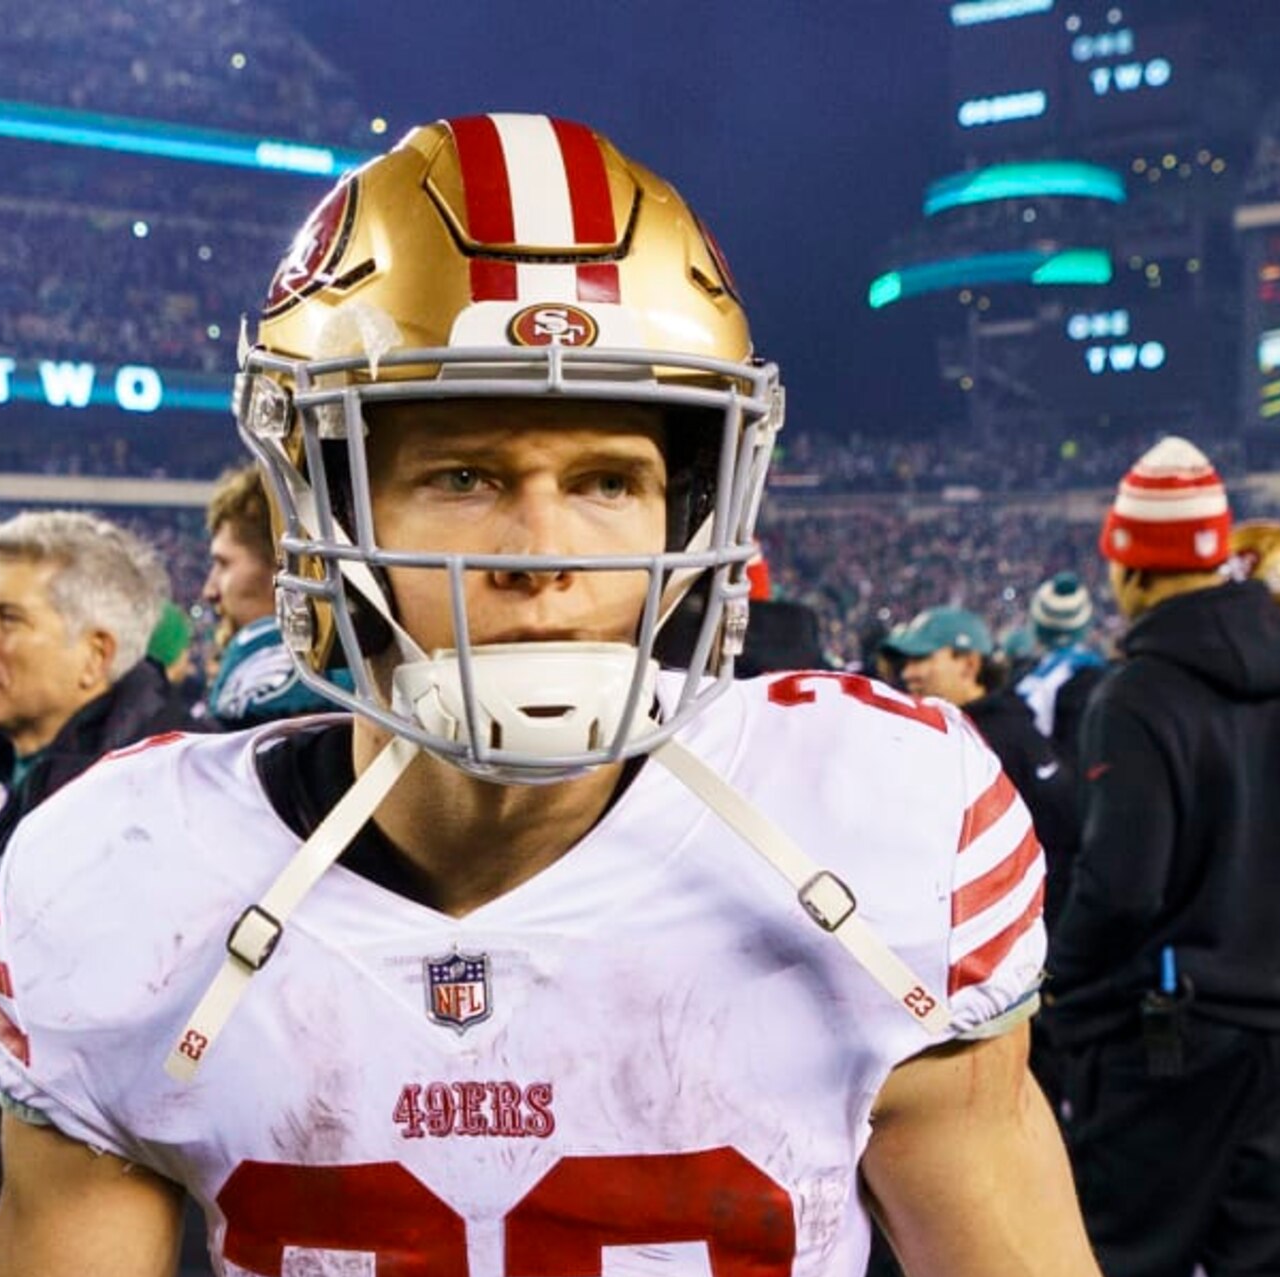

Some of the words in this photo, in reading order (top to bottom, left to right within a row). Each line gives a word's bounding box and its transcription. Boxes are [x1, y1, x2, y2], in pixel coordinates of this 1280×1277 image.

[436, 982, 482, 1019] NFL
[903, 985, 936, 1018] 23
[179, 1029, 208, 1061] 23
[392, 1080, 556, 1140] 49ERS
